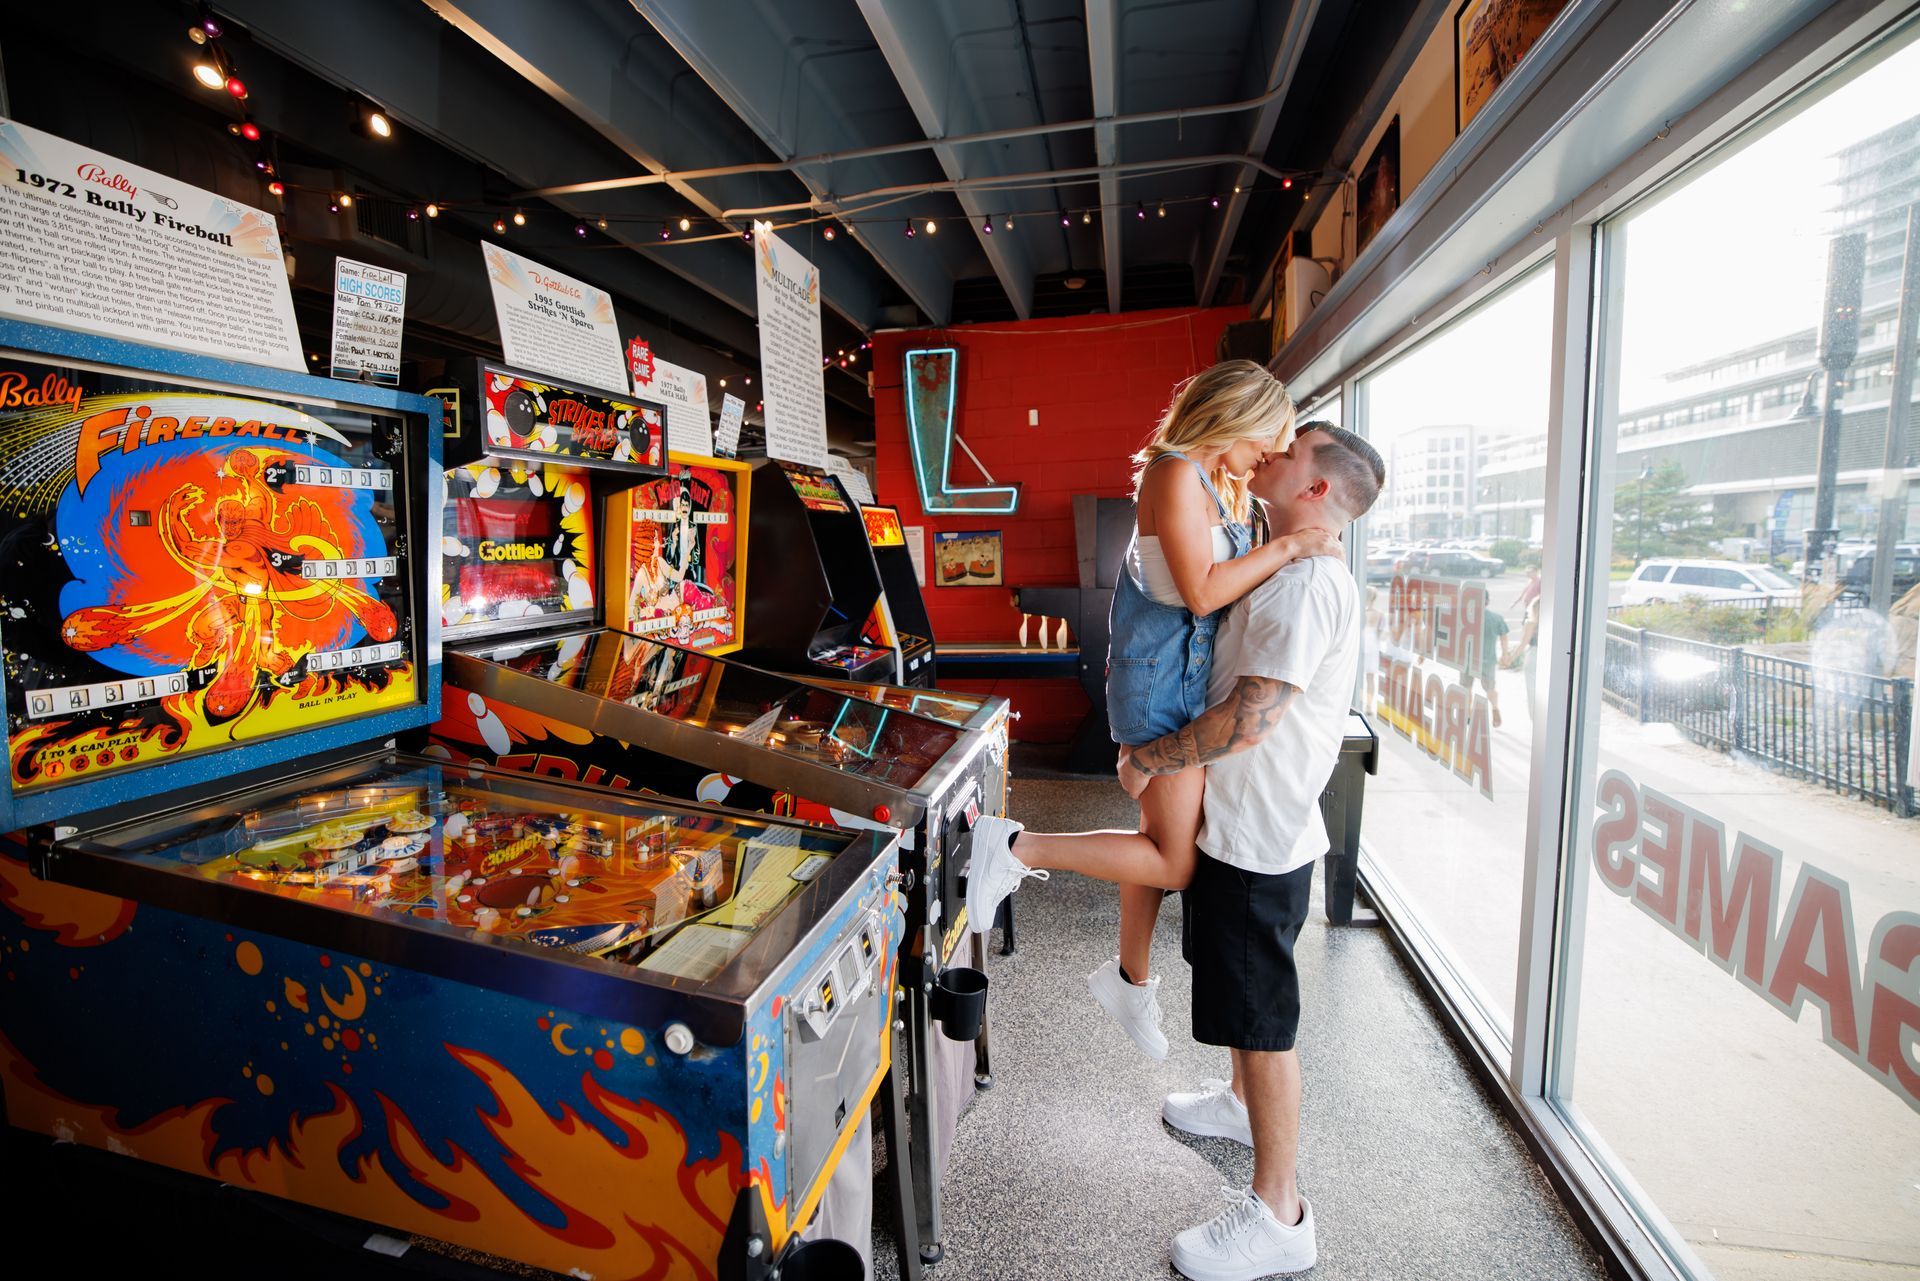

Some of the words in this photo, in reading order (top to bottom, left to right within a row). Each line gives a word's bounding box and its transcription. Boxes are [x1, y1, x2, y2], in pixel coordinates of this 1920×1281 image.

[77, 163, 138, 200] Bally
[2, 184, 20, 195] The
[22, 190, 57, 206] ultimate
[59, 201, 100, 219] collectible
[102, 216, 123, 228] game
[125, 221, 133, 229] of
[134, 224, 146, 233] the
[164, 233, 197, 249] according
[206, 245, 216, 253] the
[15, 168, 77, 199] 1972
[85, 189, 147, 223] Bally
[152, 211, 234, 248] Fireball
[14, 211, 29, 220] run
[31, 216, 49, 225] was
[51, 219, 73, 233] 3,815
[99, 233, 120, 247] Many
[122, 239, 140, 250] firsts
[162, 251, 174, 260] The
[176, 255, 207, 269] whirlwind
[19, 199, 49, 216] charge
[94, 221, 109, 232] and
[111, 226, 130, 238] Dave
[172, 244, 211, 261] Christensen
[12, 219, 24, 229] off
[27, 223, 41, 233] the
[43, 227, 58, 238] ball
[61, 234, 81, 244] once
[84, 238, 106, 251] rolled
[139, 255, 177, 271] messenger
[178, 264, 190, 274] ball
[29, 245, 60, 259] returns
[62, 255, 80, 266] your
[82, 258, 97, 269] ball
[135, 272, 149, 282] free
[151, 276, 164, 285] ball
[165, 280, 181, 291] gate
[182, 284, 205, 295] returns
[207, 292, 220, 301] your
[38, 237, 54, 248] The
[57, 242, 68, 251] art
[71, 245, 105, 262] package
[115, 257, 132, 269] truly
[174, 272, 204, 286] lower-left
[340, 265, 360, 277] Game:
[337, 293, 354, 304] Male:
[339, 276, 363, 296] HIGH
[365, 281, 402, 303] SCORES
[771, 267, 812, 305] MULTICADE
[336, 306, 360, 318] Female:
[528, 300, 557, 318] Strikes
[570, 315, 595, 331] Spares
[534, 292, 553, 306] 1995
[555, 300, 586, 319] Gottlieb
[335, 331, 358, 342] Female:
[336, 319, 353, 329] Male:
[334, 356, 358, 367] Female:
[335, 344, 351, 353] Male:
[632, 344, 649, 362] RARE
[633, 361, 650, 379] GAME
[0, 372, 83, 414] Bally
[659, 388, 675, 399] MATA
[660, 380, 673, 391] 1977
[673, 384, 686, 394] Bally
[548, 399, 606, 432] STRIKES
[571, 422, 618, 451] SPARES
[479, 541, 544, 561] Gottlieb
[299, 700, 321, 710] BALL
[324, 697, 333, 705] IN
[336, 692, 358, 701] PLAY
[40, 750, 47, 761] 1
[49, 750, 65, 758] TO
[67, 744, 78, 756] 4
[80, 741, 105, 752] CAN
[107, 734, 140, 748] PLAY
